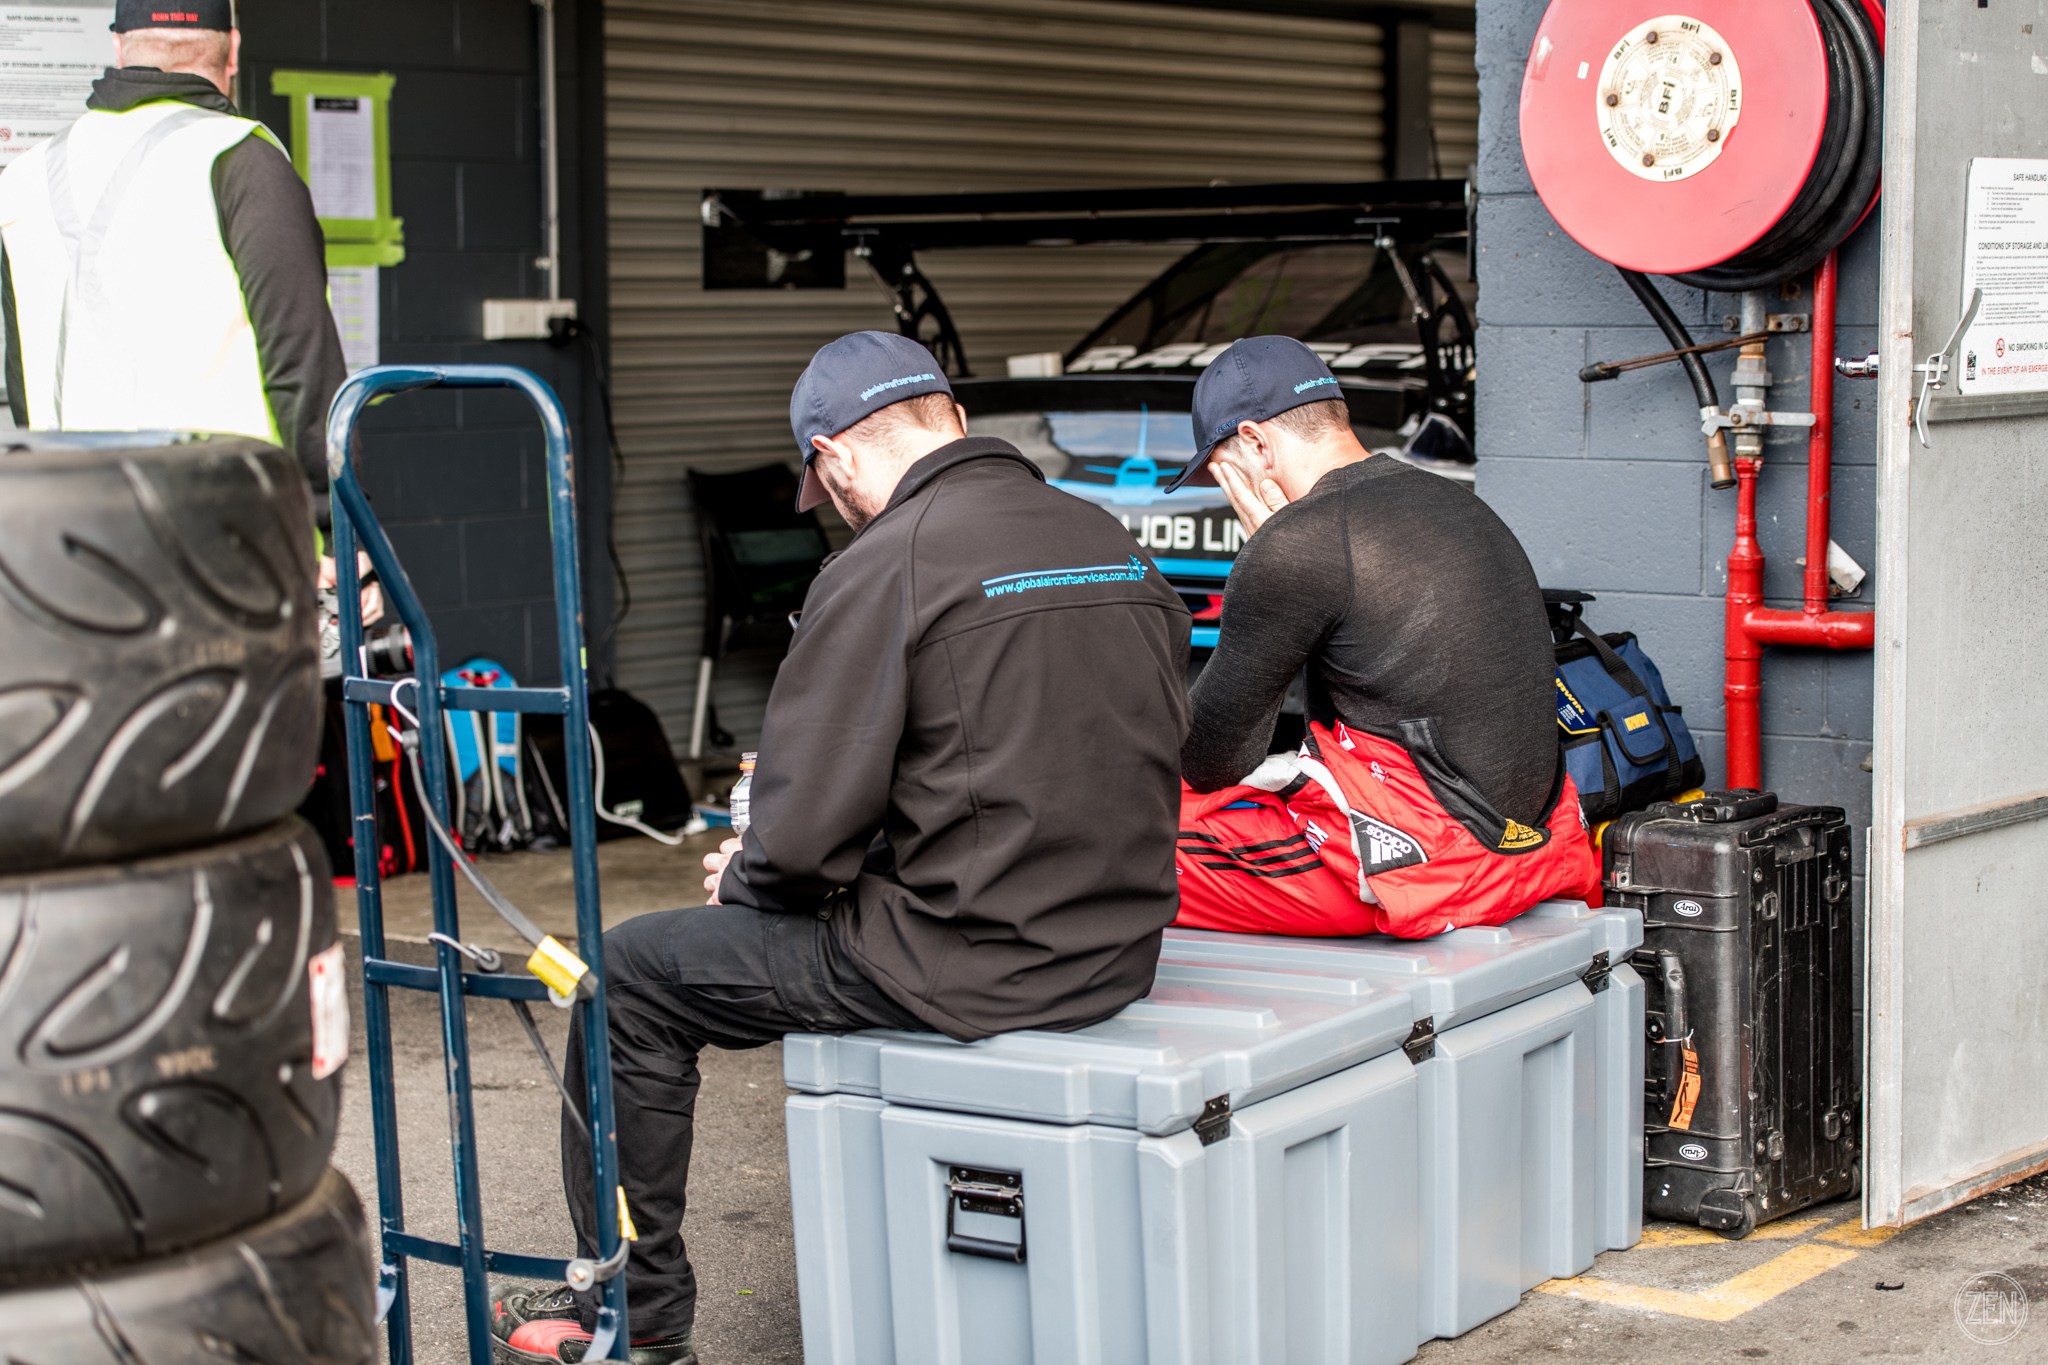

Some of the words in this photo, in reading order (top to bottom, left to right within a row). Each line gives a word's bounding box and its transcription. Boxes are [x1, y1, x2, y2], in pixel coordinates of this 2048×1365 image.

[151, 12, 169, 21] BORN
[170, 12, 185, 21] THIS
[186, 13, 198, 22] WAY
[2013, 173, 2024, 182] SAFE
[2025, 173, 2047, 182] HANDLING
[1977, 242, 2004, 250] CONDITIONS
[2005, 242, 2011, 250] OF
[2012, 241, 2032, 250] STORAGE
[2033, 241, 2042, 249] AND
[2008, 343, 2015, 351] NO
[2016, 342, 2038, 351] SMOKING
[1987, 366, 1996, 375] THE
[1997, 365, 2012, 375] EVENT
[984, 572, 1139, 598] www.globalaircraftservices.com.au
[1365, 824, 1413, 854] adidas
